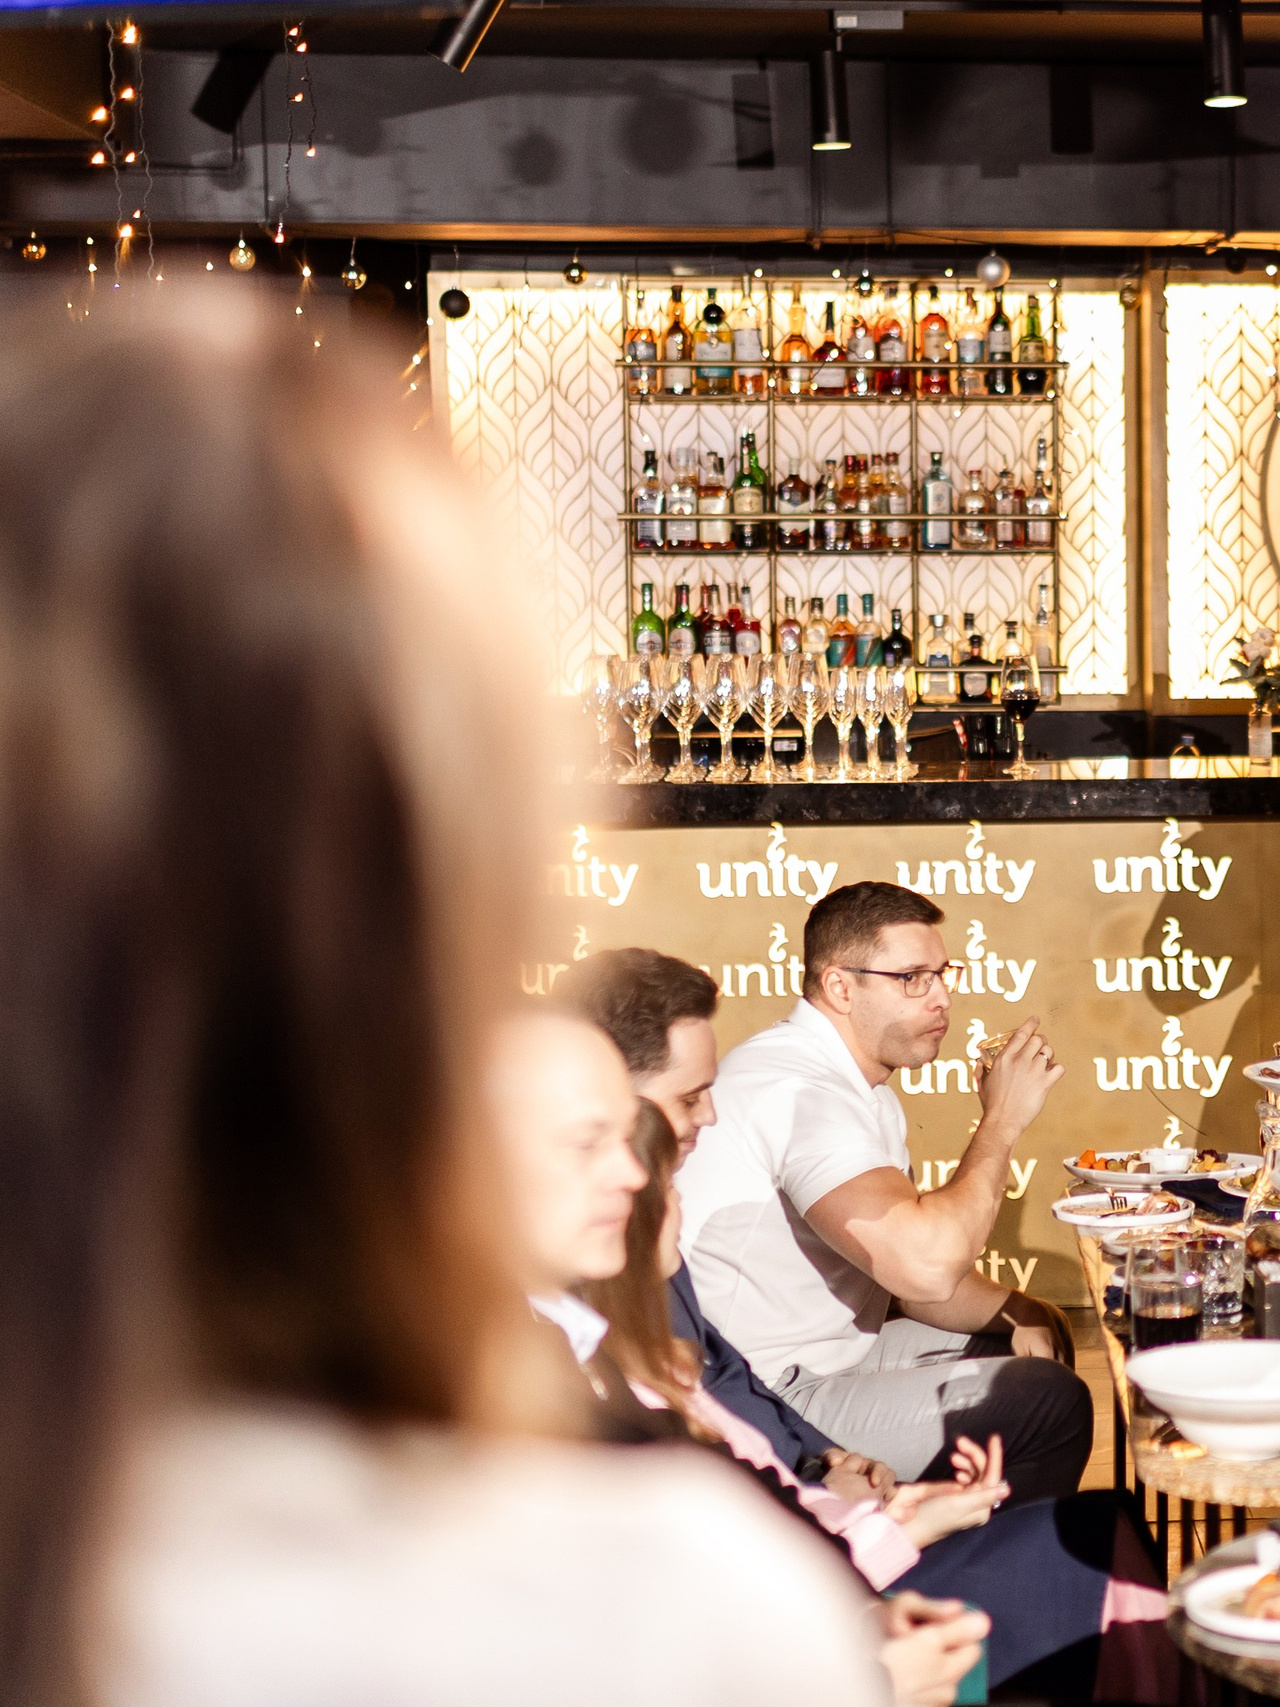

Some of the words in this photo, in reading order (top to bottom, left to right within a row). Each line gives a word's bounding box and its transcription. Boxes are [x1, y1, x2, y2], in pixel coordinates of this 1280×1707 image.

[548, 824, 639, 906] nity
[696, 821, 838, 905] unity
[895, 819, 1036, 903] unity
[1092, 817, 1233, 900] unity
[1093, 917, 1233, 1000] unity
[1093, 1015, 1233, 1098] unity
